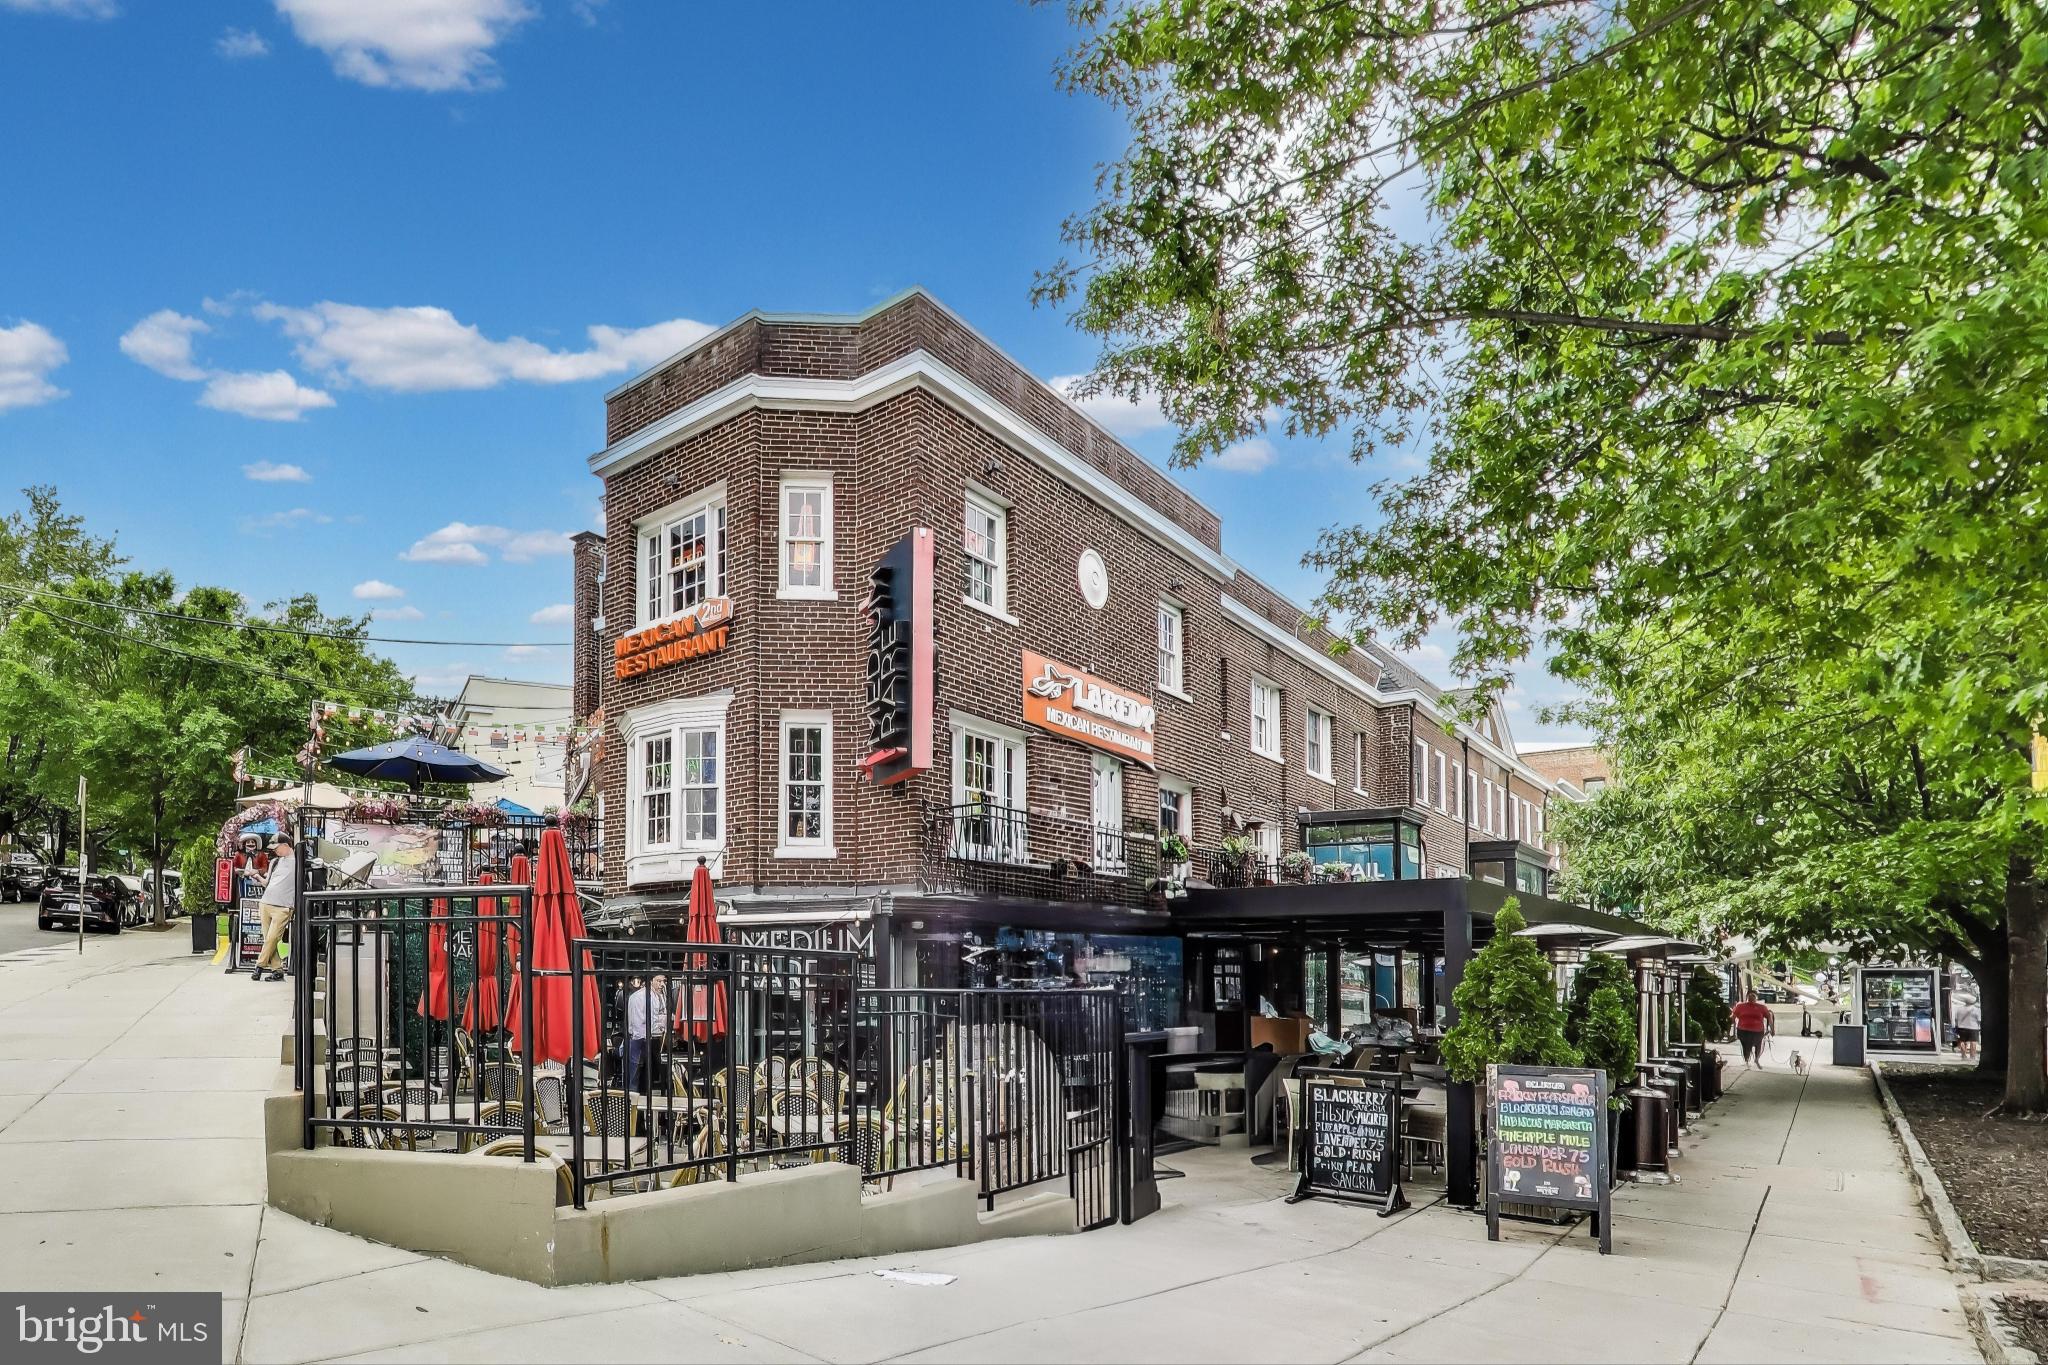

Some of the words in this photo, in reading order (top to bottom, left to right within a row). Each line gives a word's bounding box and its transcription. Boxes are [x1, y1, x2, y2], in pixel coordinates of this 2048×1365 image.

[700, 600, 723, 622] 2nd
[614, 614, 696, 659] MEXICAN
[614, 625, 730, 680] RESTAURANT
[865, 566, 893, 747] MEDIUM
[880, 619, 909, 741] RARE
[1072, 679, 1156, 734] LAREDO
[1046, 706, 1090, 734] MEXICAN
[333, 838, 369, 847] LAREDO
[741, 924, 875, 958] MEDIUM
[1313, 1087, 1388, 1105] BLACKBERRY
[1368, 1138, 1385, 1152] 75
[1498, 1129, 1556, 1144] PINEAPPLE
[1559, 1133, 1591, 1147] MULE
[1314, 1145, 1346, 1158] GOLD
[1351, 1148, 1381, 1162] RUSH
[1500, 1142, 1568, 1160] LAVENDER
[1568, 1149, 1590, 1164] 75
[1345, 1160, 1374, 1174] PEAR
[1503, 1155, 1537, 1169] GOLD
[1542, 1158, 1582, 1176] RUSH
